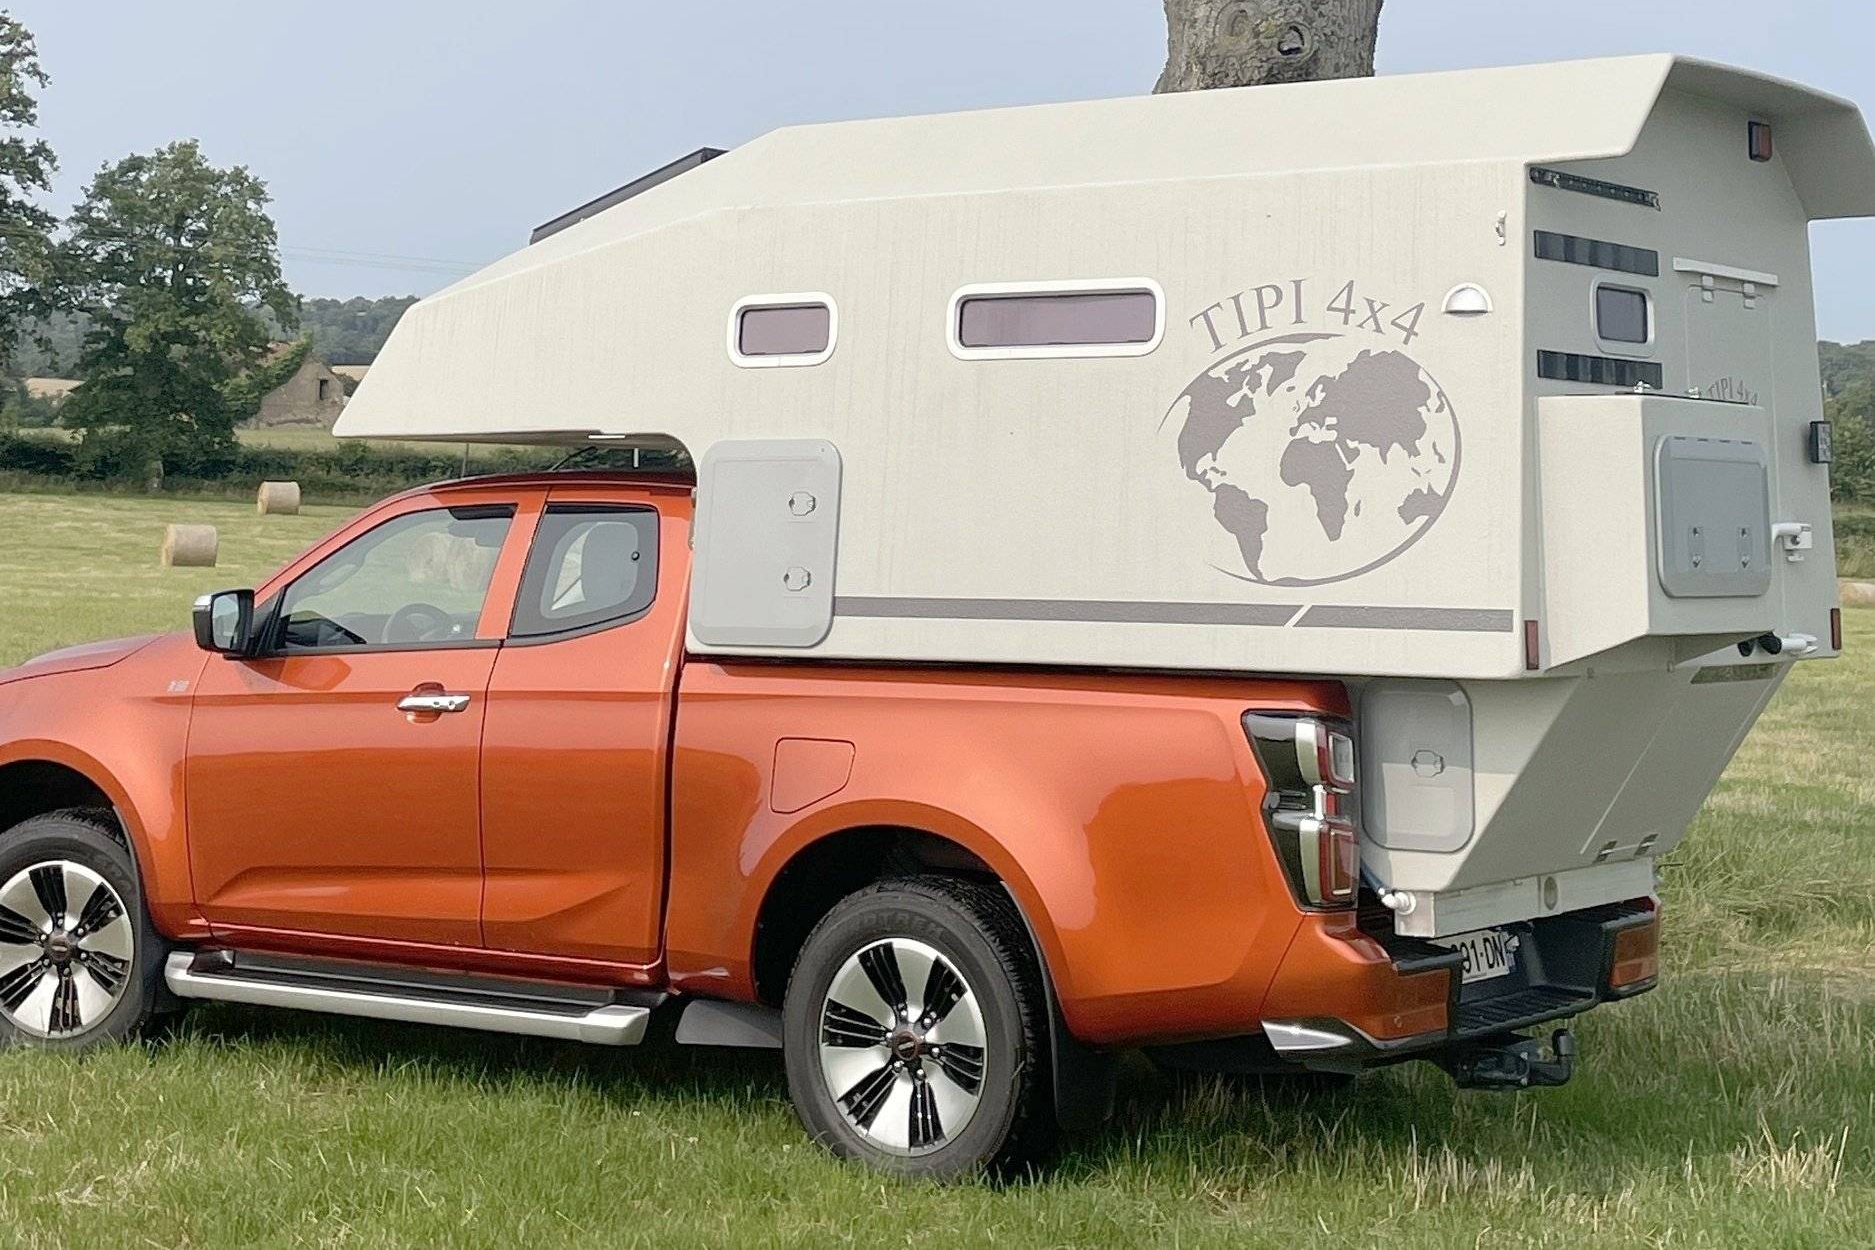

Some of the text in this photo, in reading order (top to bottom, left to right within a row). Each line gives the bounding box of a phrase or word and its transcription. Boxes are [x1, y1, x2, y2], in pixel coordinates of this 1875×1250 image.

[1188, 277, 1425, 354] TIPI 4x4
[1707, 376, 1733, 400] TIPI
